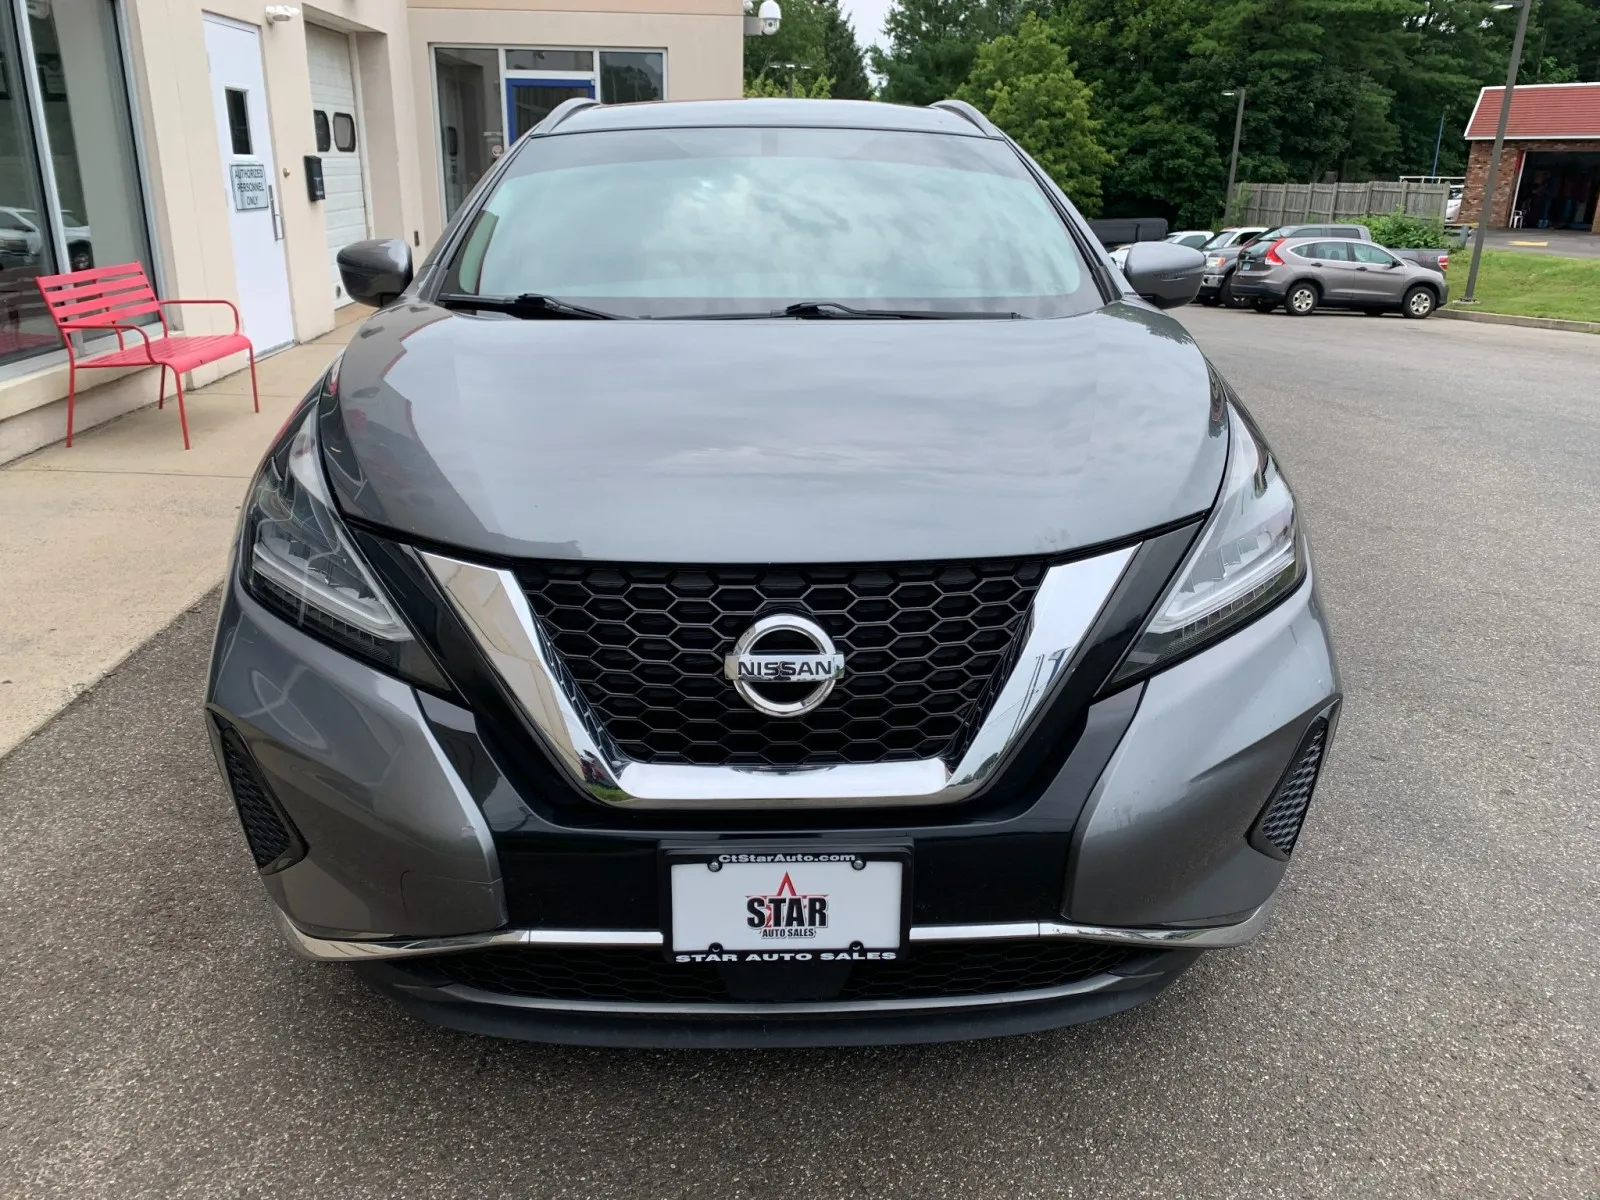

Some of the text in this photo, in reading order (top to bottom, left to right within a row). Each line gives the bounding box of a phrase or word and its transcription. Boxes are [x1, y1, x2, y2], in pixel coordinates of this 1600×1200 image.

[235, 168, 263, 178] AUTHORIZED
[237, 182, 264, 192] PERSONNEL
[246, 196, 258, 205] ONLY
[737, 660, 832, 676] NISSAN
[718, 853, 856, 863] CtStarAuto.com
[746, 897, 828, 928] STAR
[761, 928, 815, 938] AUTO SALES
[675, 951, 897, 963] STAR AUTO SALES
